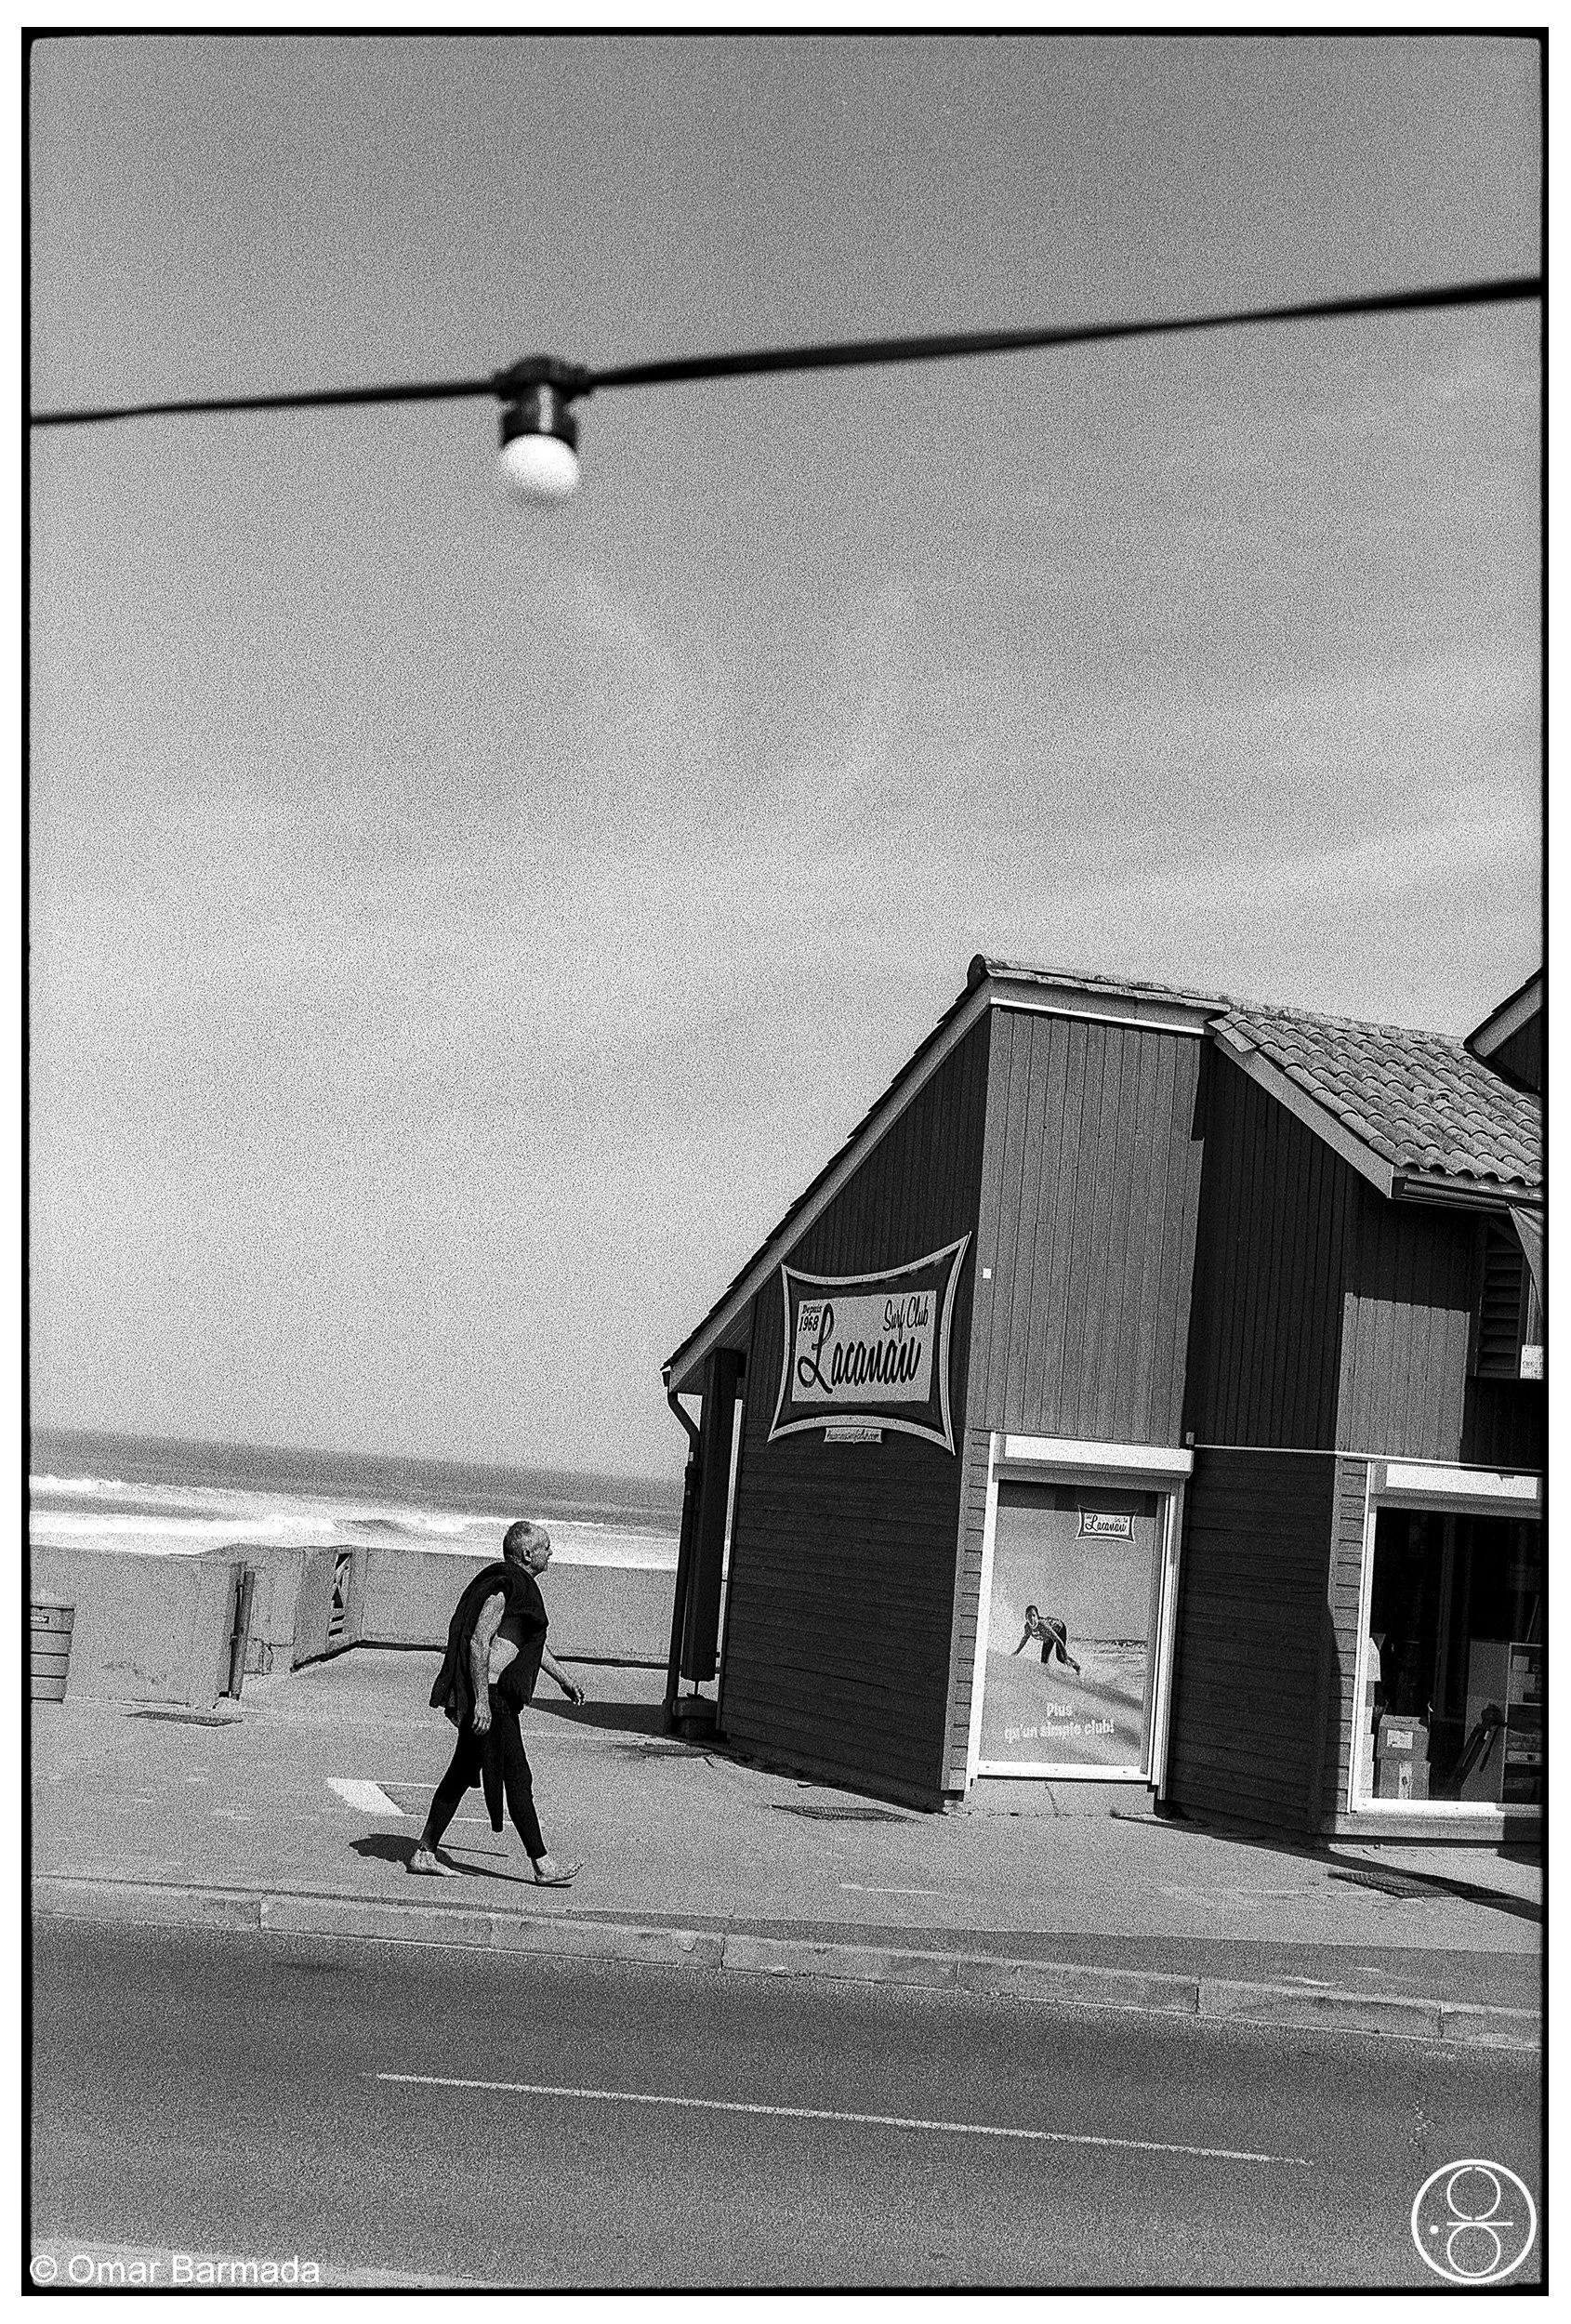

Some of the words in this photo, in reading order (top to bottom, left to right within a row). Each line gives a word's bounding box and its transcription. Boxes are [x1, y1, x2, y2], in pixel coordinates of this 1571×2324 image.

[802, 1304, 823, 1316] Depuis
[883, 1299, 905, 1342] Surf
[906, 1296, 930, 1328] Club
[799, 1315, 819, 1331] 1968
[798, 1303, 921, 1393] Lacanau
[1085, 1514, 1127, 1533] Lacanau
[1047, 1702, 1074, 1717] Plus
[1005, 1723, 1038, 1744] qu'un
[1040, 1721, 1082, 1740] simple
[1084, 1718, 1115, 1736] club!
